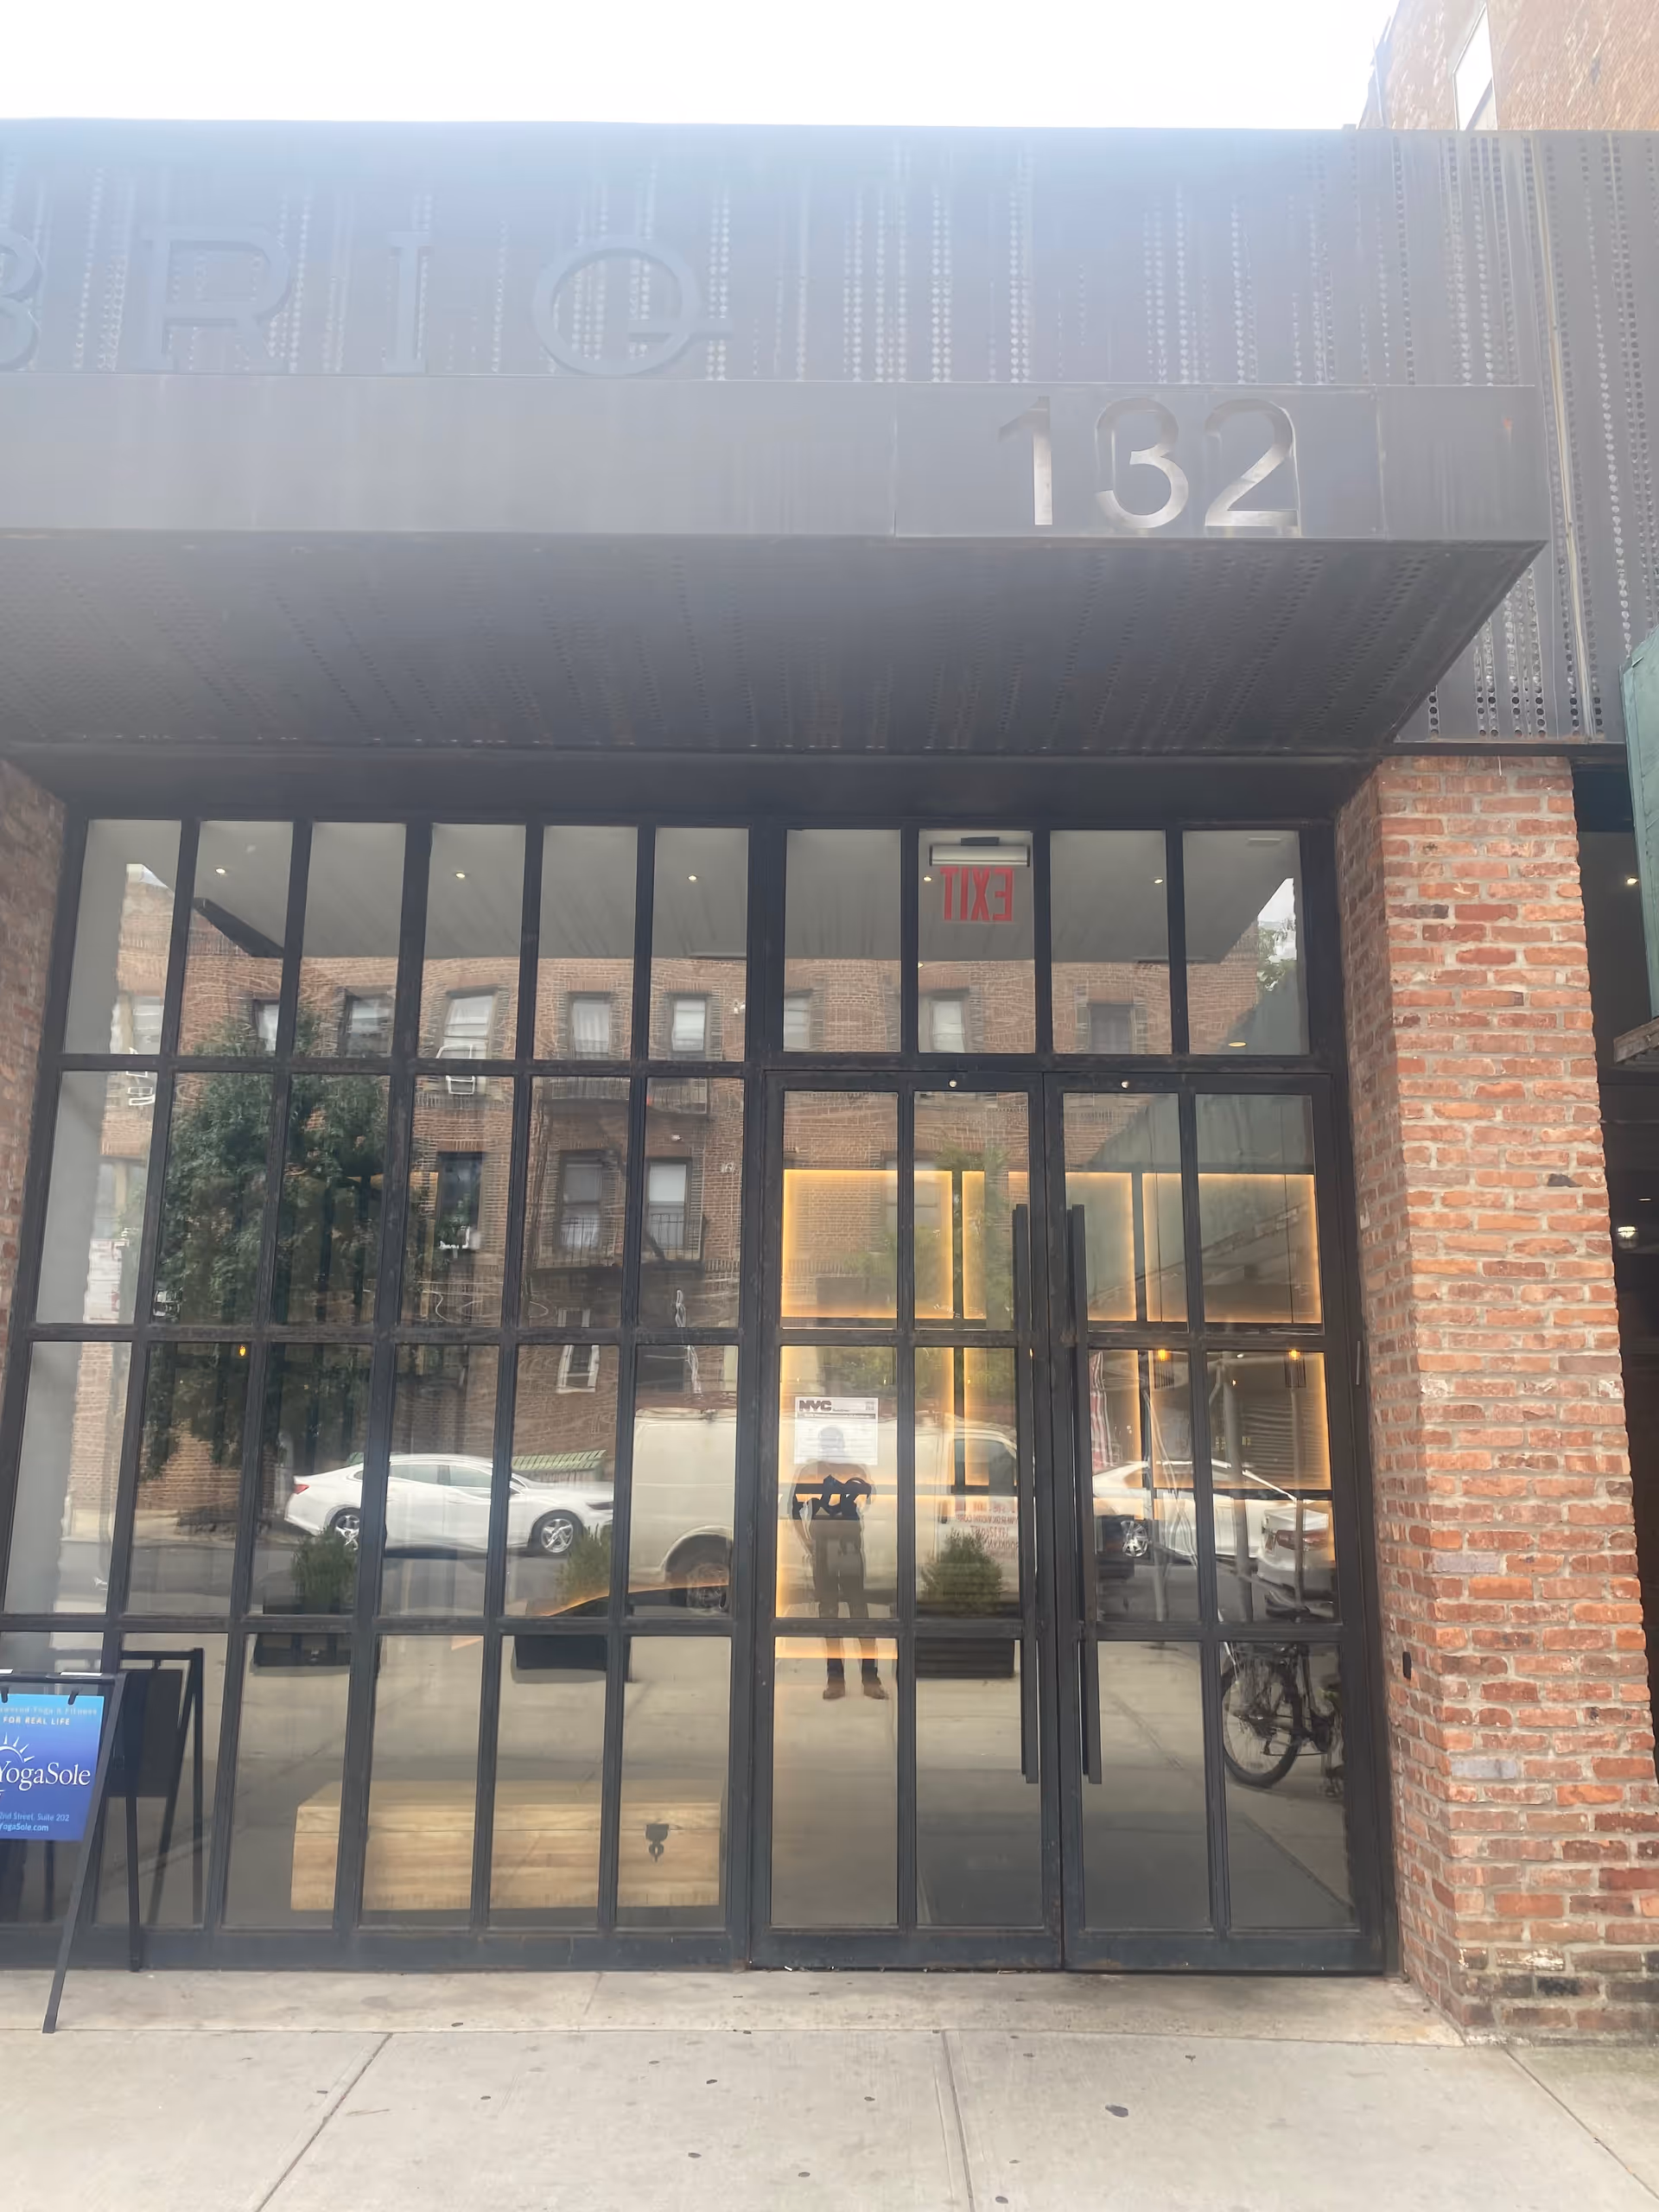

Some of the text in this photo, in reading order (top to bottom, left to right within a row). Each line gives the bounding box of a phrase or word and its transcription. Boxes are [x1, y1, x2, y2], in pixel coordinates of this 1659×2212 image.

[998, 396, 1299, 529] 132
[799, 1400, 832, 1413] NYC
[0, 1760, 91, 1791] YogaSole
